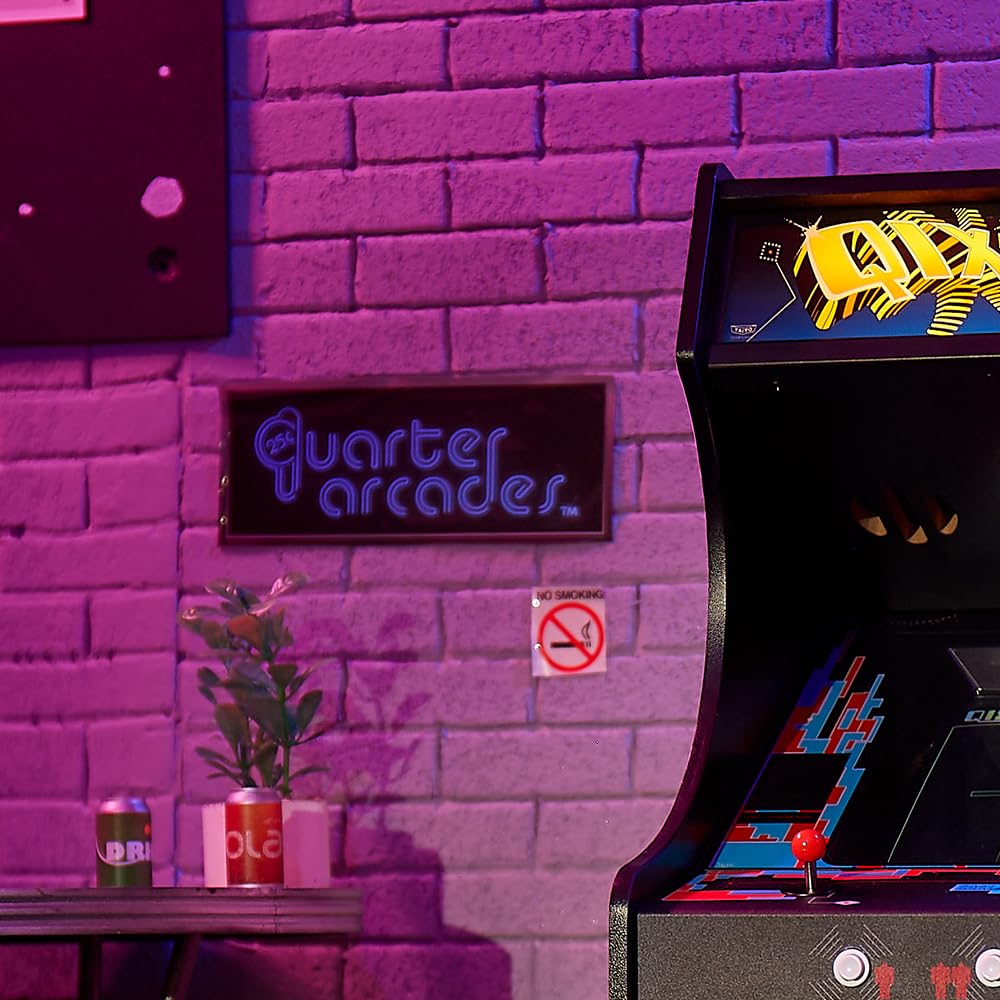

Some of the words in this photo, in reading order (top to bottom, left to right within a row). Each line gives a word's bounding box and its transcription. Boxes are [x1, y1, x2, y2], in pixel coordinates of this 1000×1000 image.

[318, 474, 567, 518] arcades
[537, 590, 552, 600] NO
[554, 589, 605, 600] SMOKING
